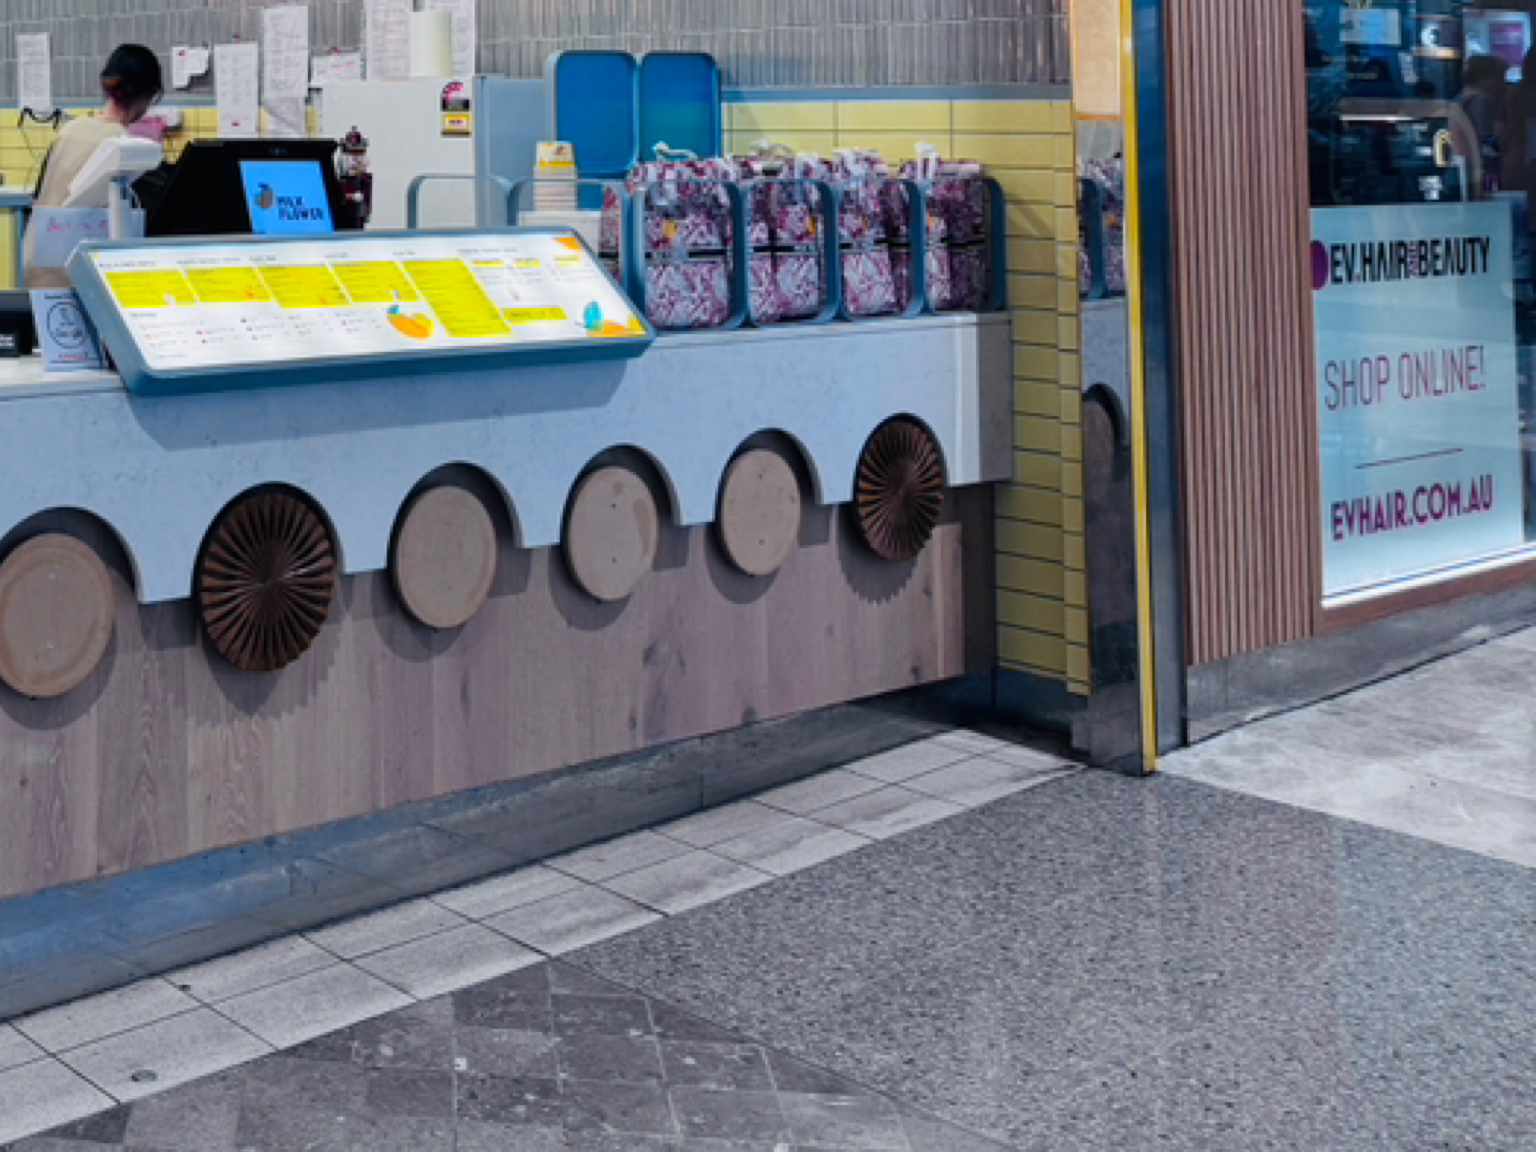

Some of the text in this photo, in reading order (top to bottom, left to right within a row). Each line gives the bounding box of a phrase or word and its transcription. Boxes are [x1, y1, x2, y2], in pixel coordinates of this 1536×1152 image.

[1324, 344, 1486, 410] SHOP ONLINE!
[1329, 473, 1495, 542] EVHAIR.COM.AU
